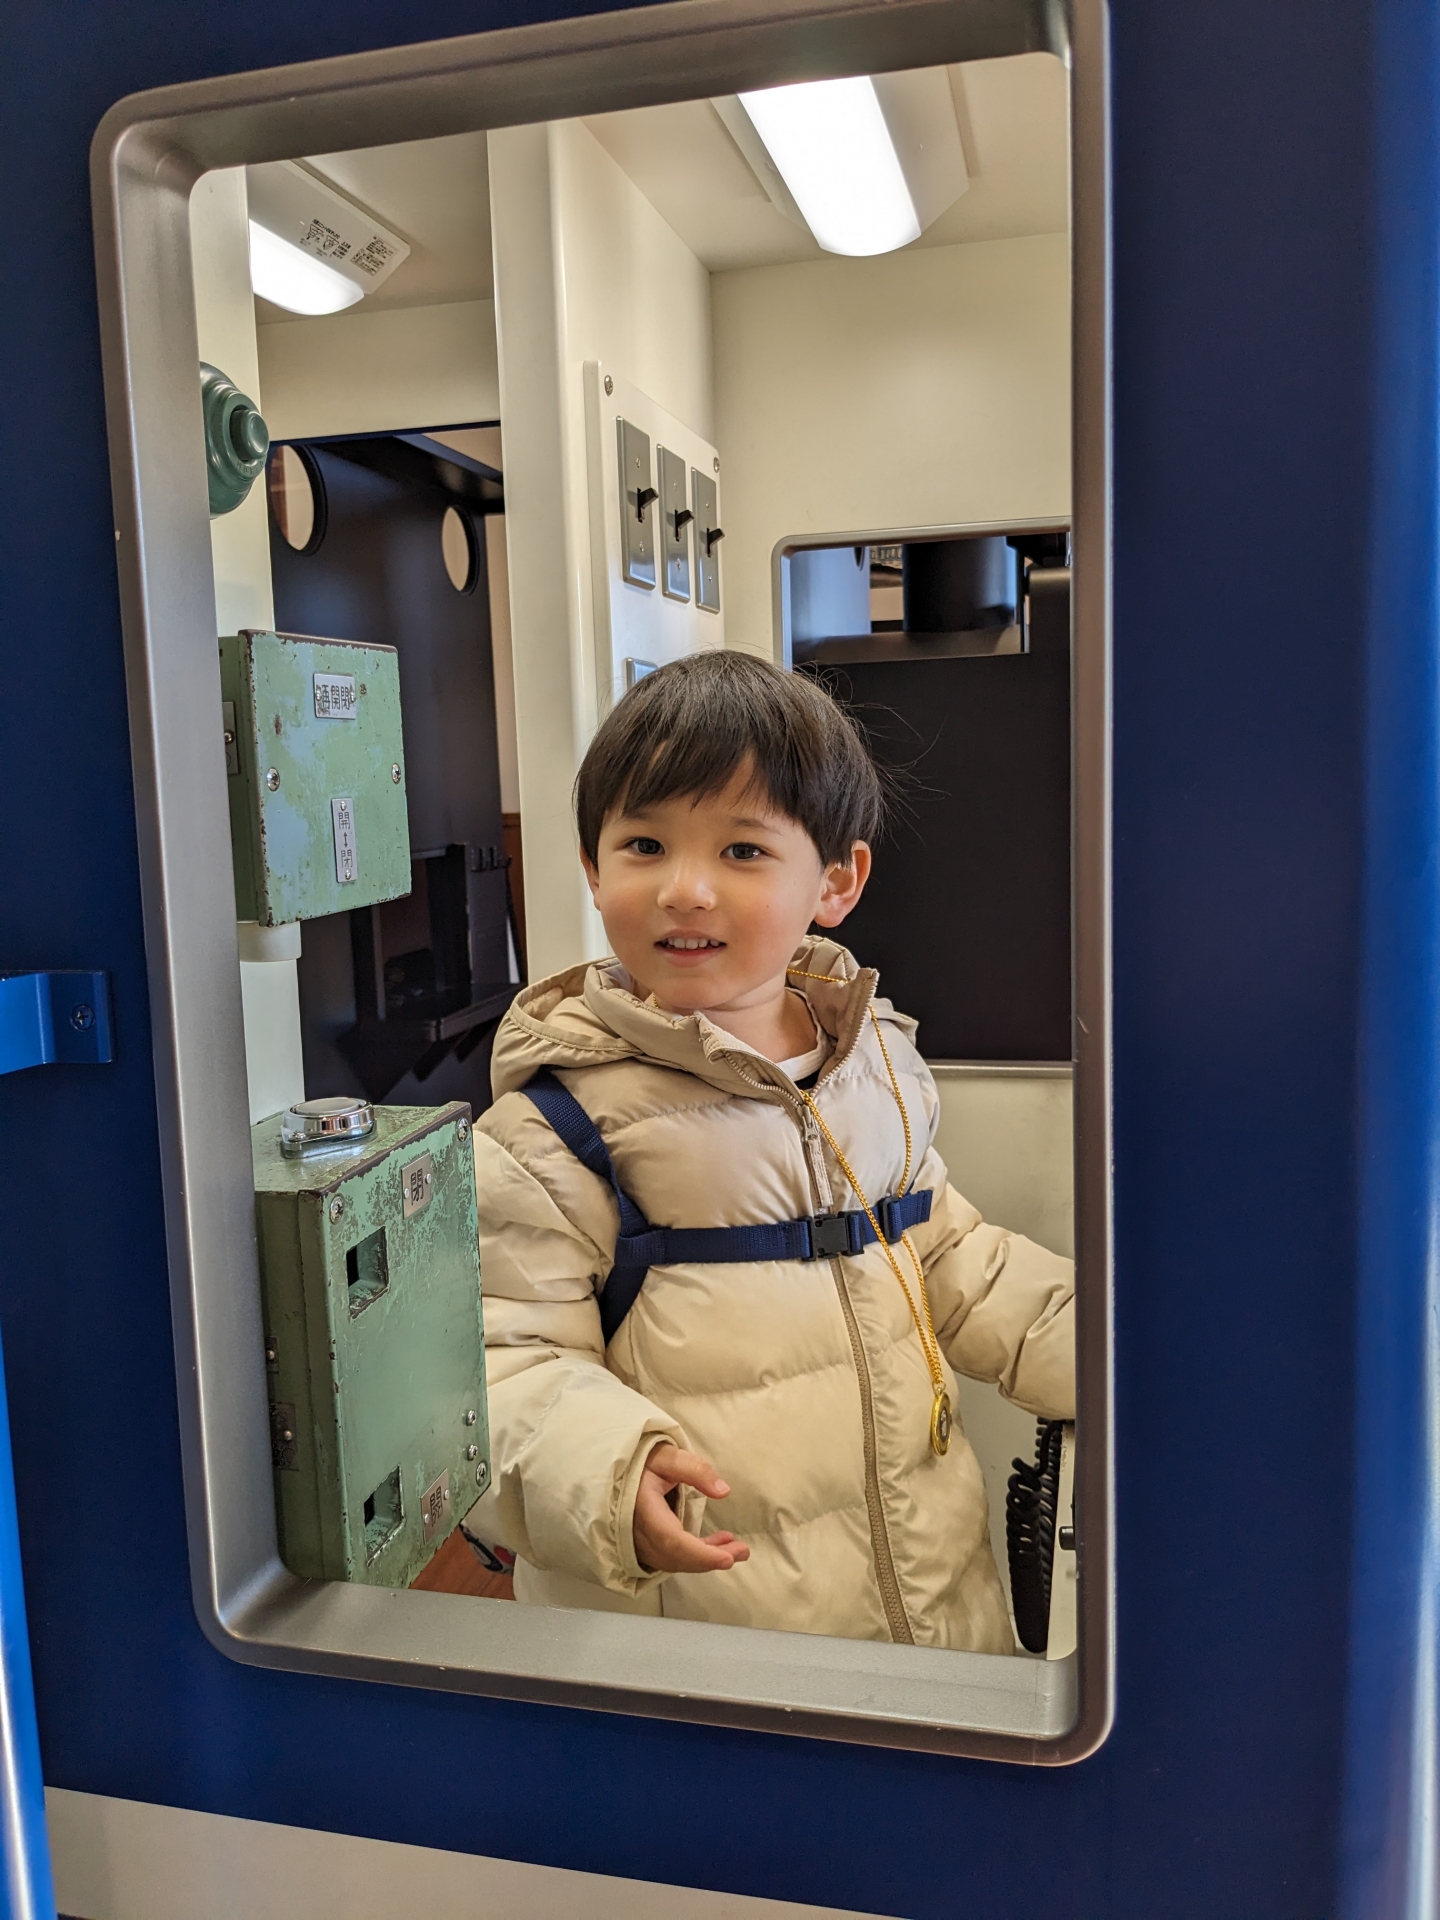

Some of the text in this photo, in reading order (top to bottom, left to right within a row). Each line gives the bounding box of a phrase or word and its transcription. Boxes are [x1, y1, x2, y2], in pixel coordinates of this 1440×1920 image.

[338, 811, 351, 830] 開
[340, 849, 353, 868] 閉
[410, 1168, 424, 1206] 閉
